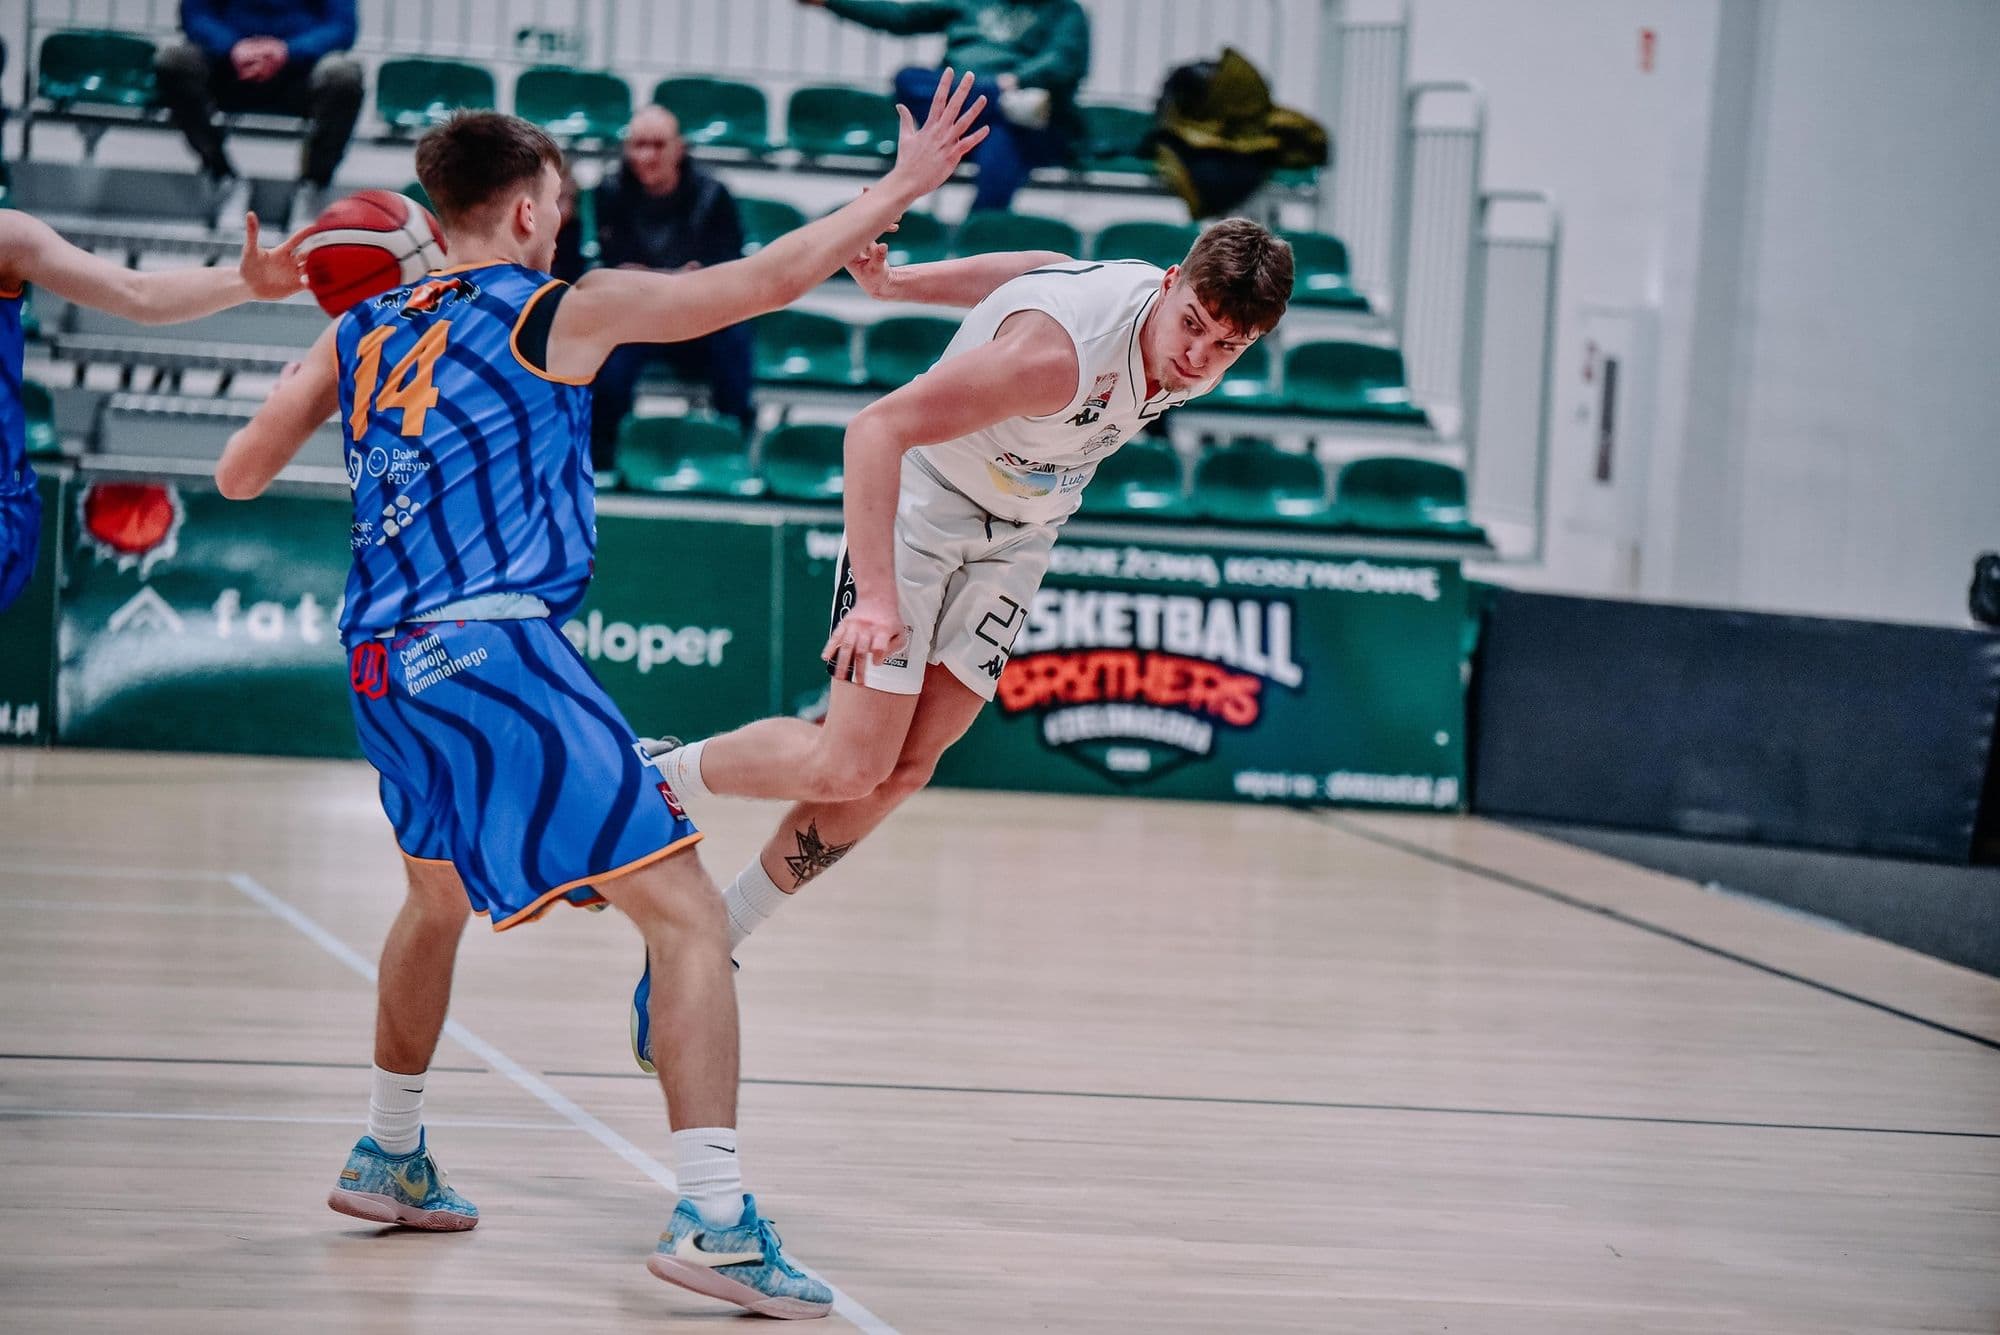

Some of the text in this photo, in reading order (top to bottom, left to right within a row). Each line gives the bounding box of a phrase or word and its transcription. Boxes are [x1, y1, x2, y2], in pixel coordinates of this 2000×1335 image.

[349, 319, 452, 441] 14
[387, 473, 410, 484] PZU
[212, 588, 344, 643] fat
[560, 609, 732, 674] eloper
[400, 633, 440, 666] Centrum
[1010, 588, 1303, 688] SKETBALL
[404, 648, 447, 681] Rozwoju
[406, 647, 488, 697] Komunalnego
